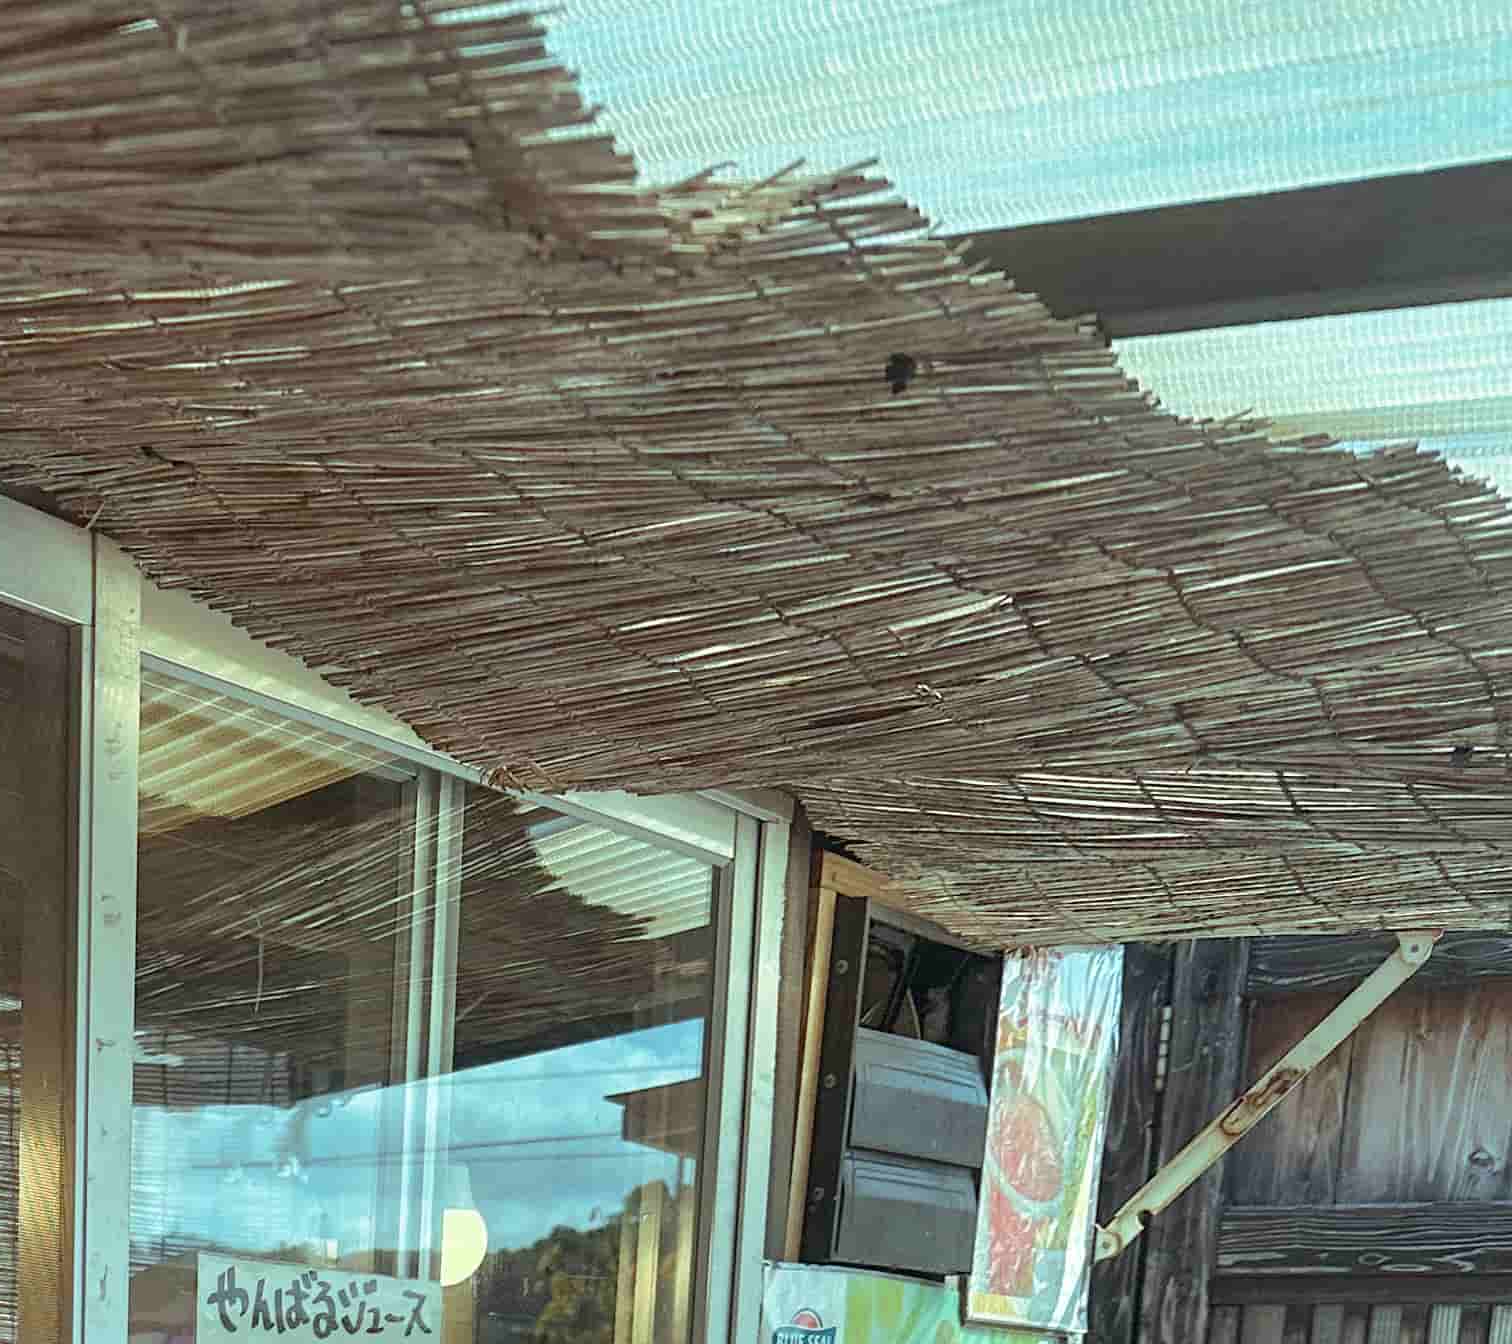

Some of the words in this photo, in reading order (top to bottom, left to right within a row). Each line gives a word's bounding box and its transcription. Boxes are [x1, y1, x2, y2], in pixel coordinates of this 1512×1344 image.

[206, 1265, 432, 1339] やんばるジュース
